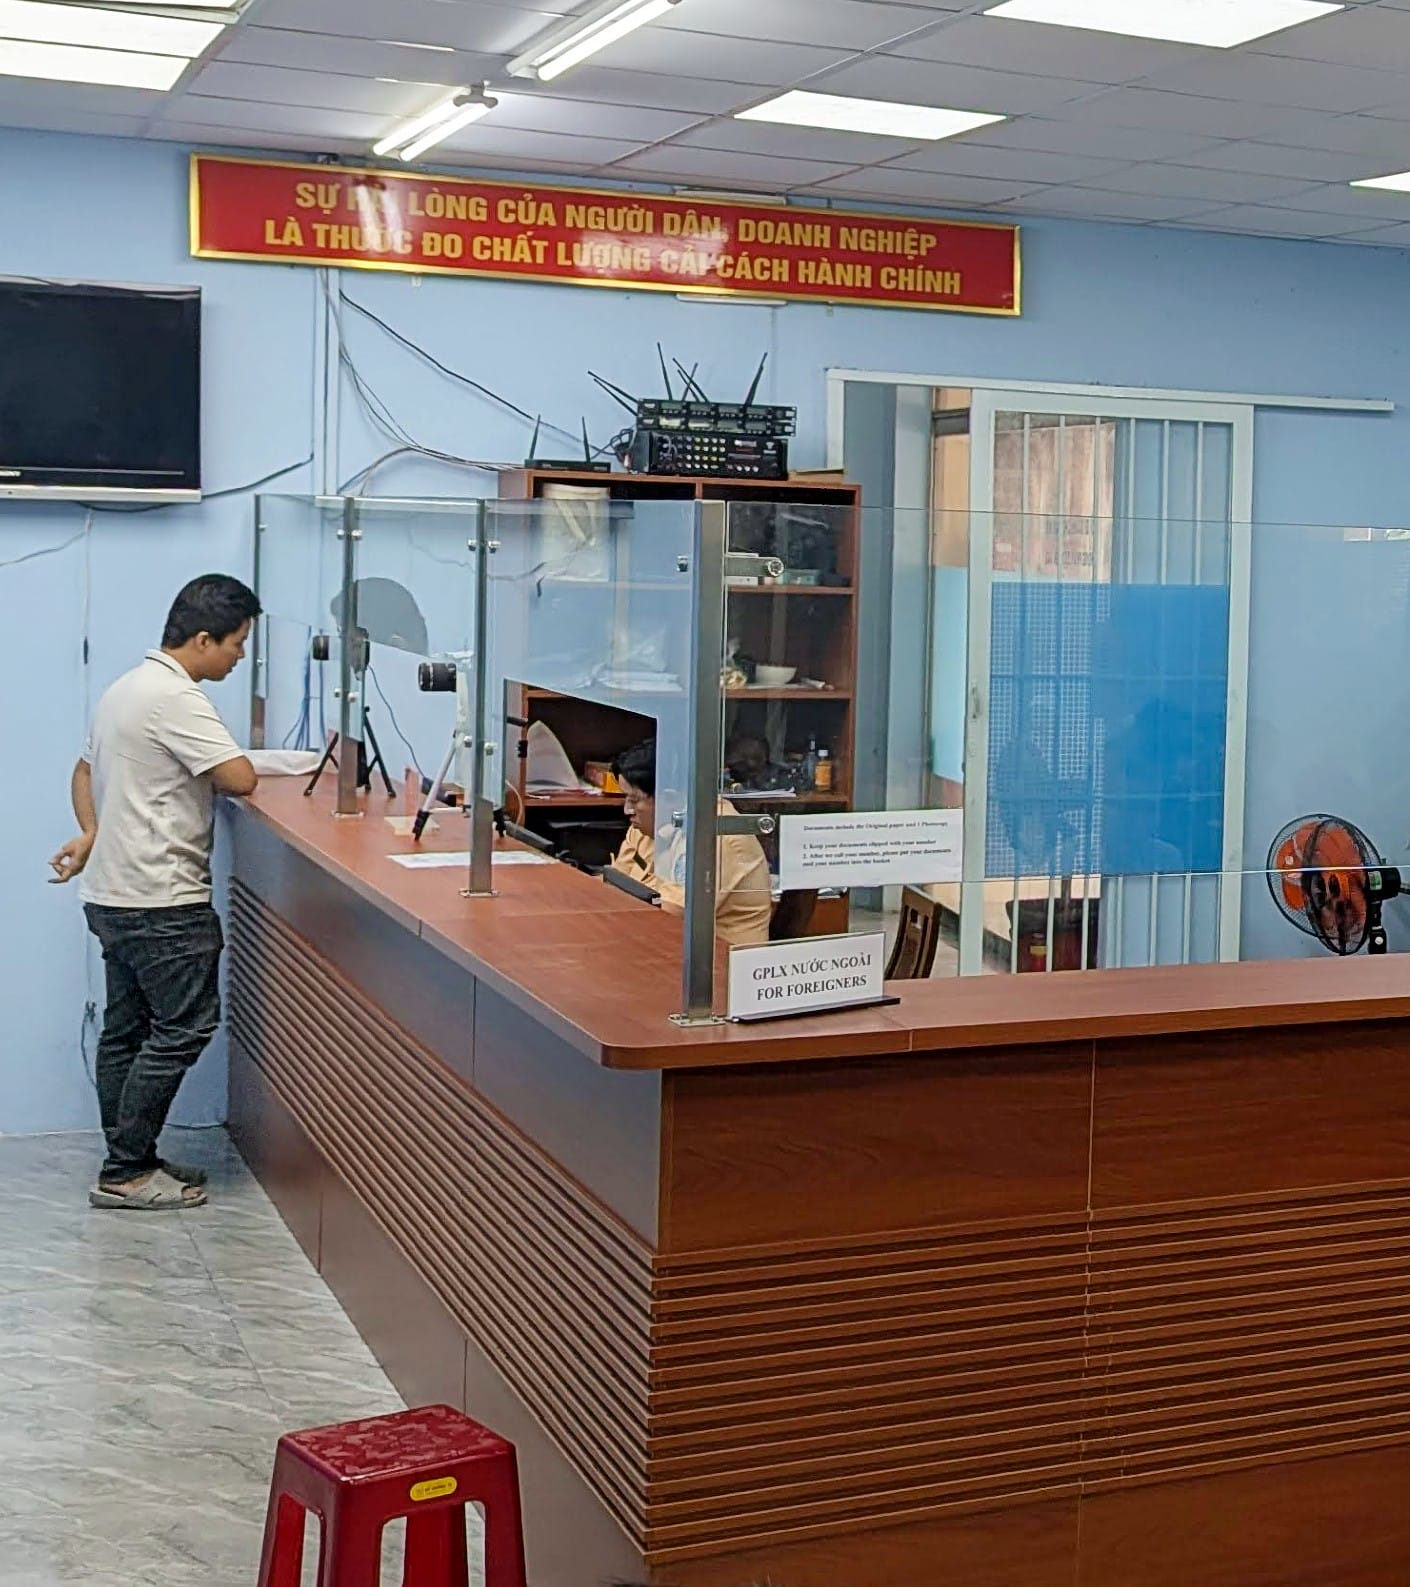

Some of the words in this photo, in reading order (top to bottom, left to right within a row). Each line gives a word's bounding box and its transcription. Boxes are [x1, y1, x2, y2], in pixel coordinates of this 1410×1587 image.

[295, 181, 341, 215] SỰ
[407, 186, 489, 222] LÒNG
[497, 192, 557, 227] CỦA
[565, 203, 654, 234] NGƯỜI
[738, 218, 831, 249] DOANH
[838, 227, 937, 261] NGHIỆP
[265, 216, 304, 247] LÀ
[421, 231, 463, 259] ĐO
[472, 230, 549, 264] CHẤT
[557, 240, 651, 274] LƯỢNG
[715, 251, 790, 283] CÁCH
[798, 256, 873, 289] HÀNH
[880, 264, 961, 295] CHÍNH
[752, 964, 788, 981] GPLX
[791, 958, 829, 976] NƯỚC
[831, 952, 872, 970] NGOÀI
[757, 985, 784, 1001] FOR
[787, 974, 867, 997] FOREIGNERS
